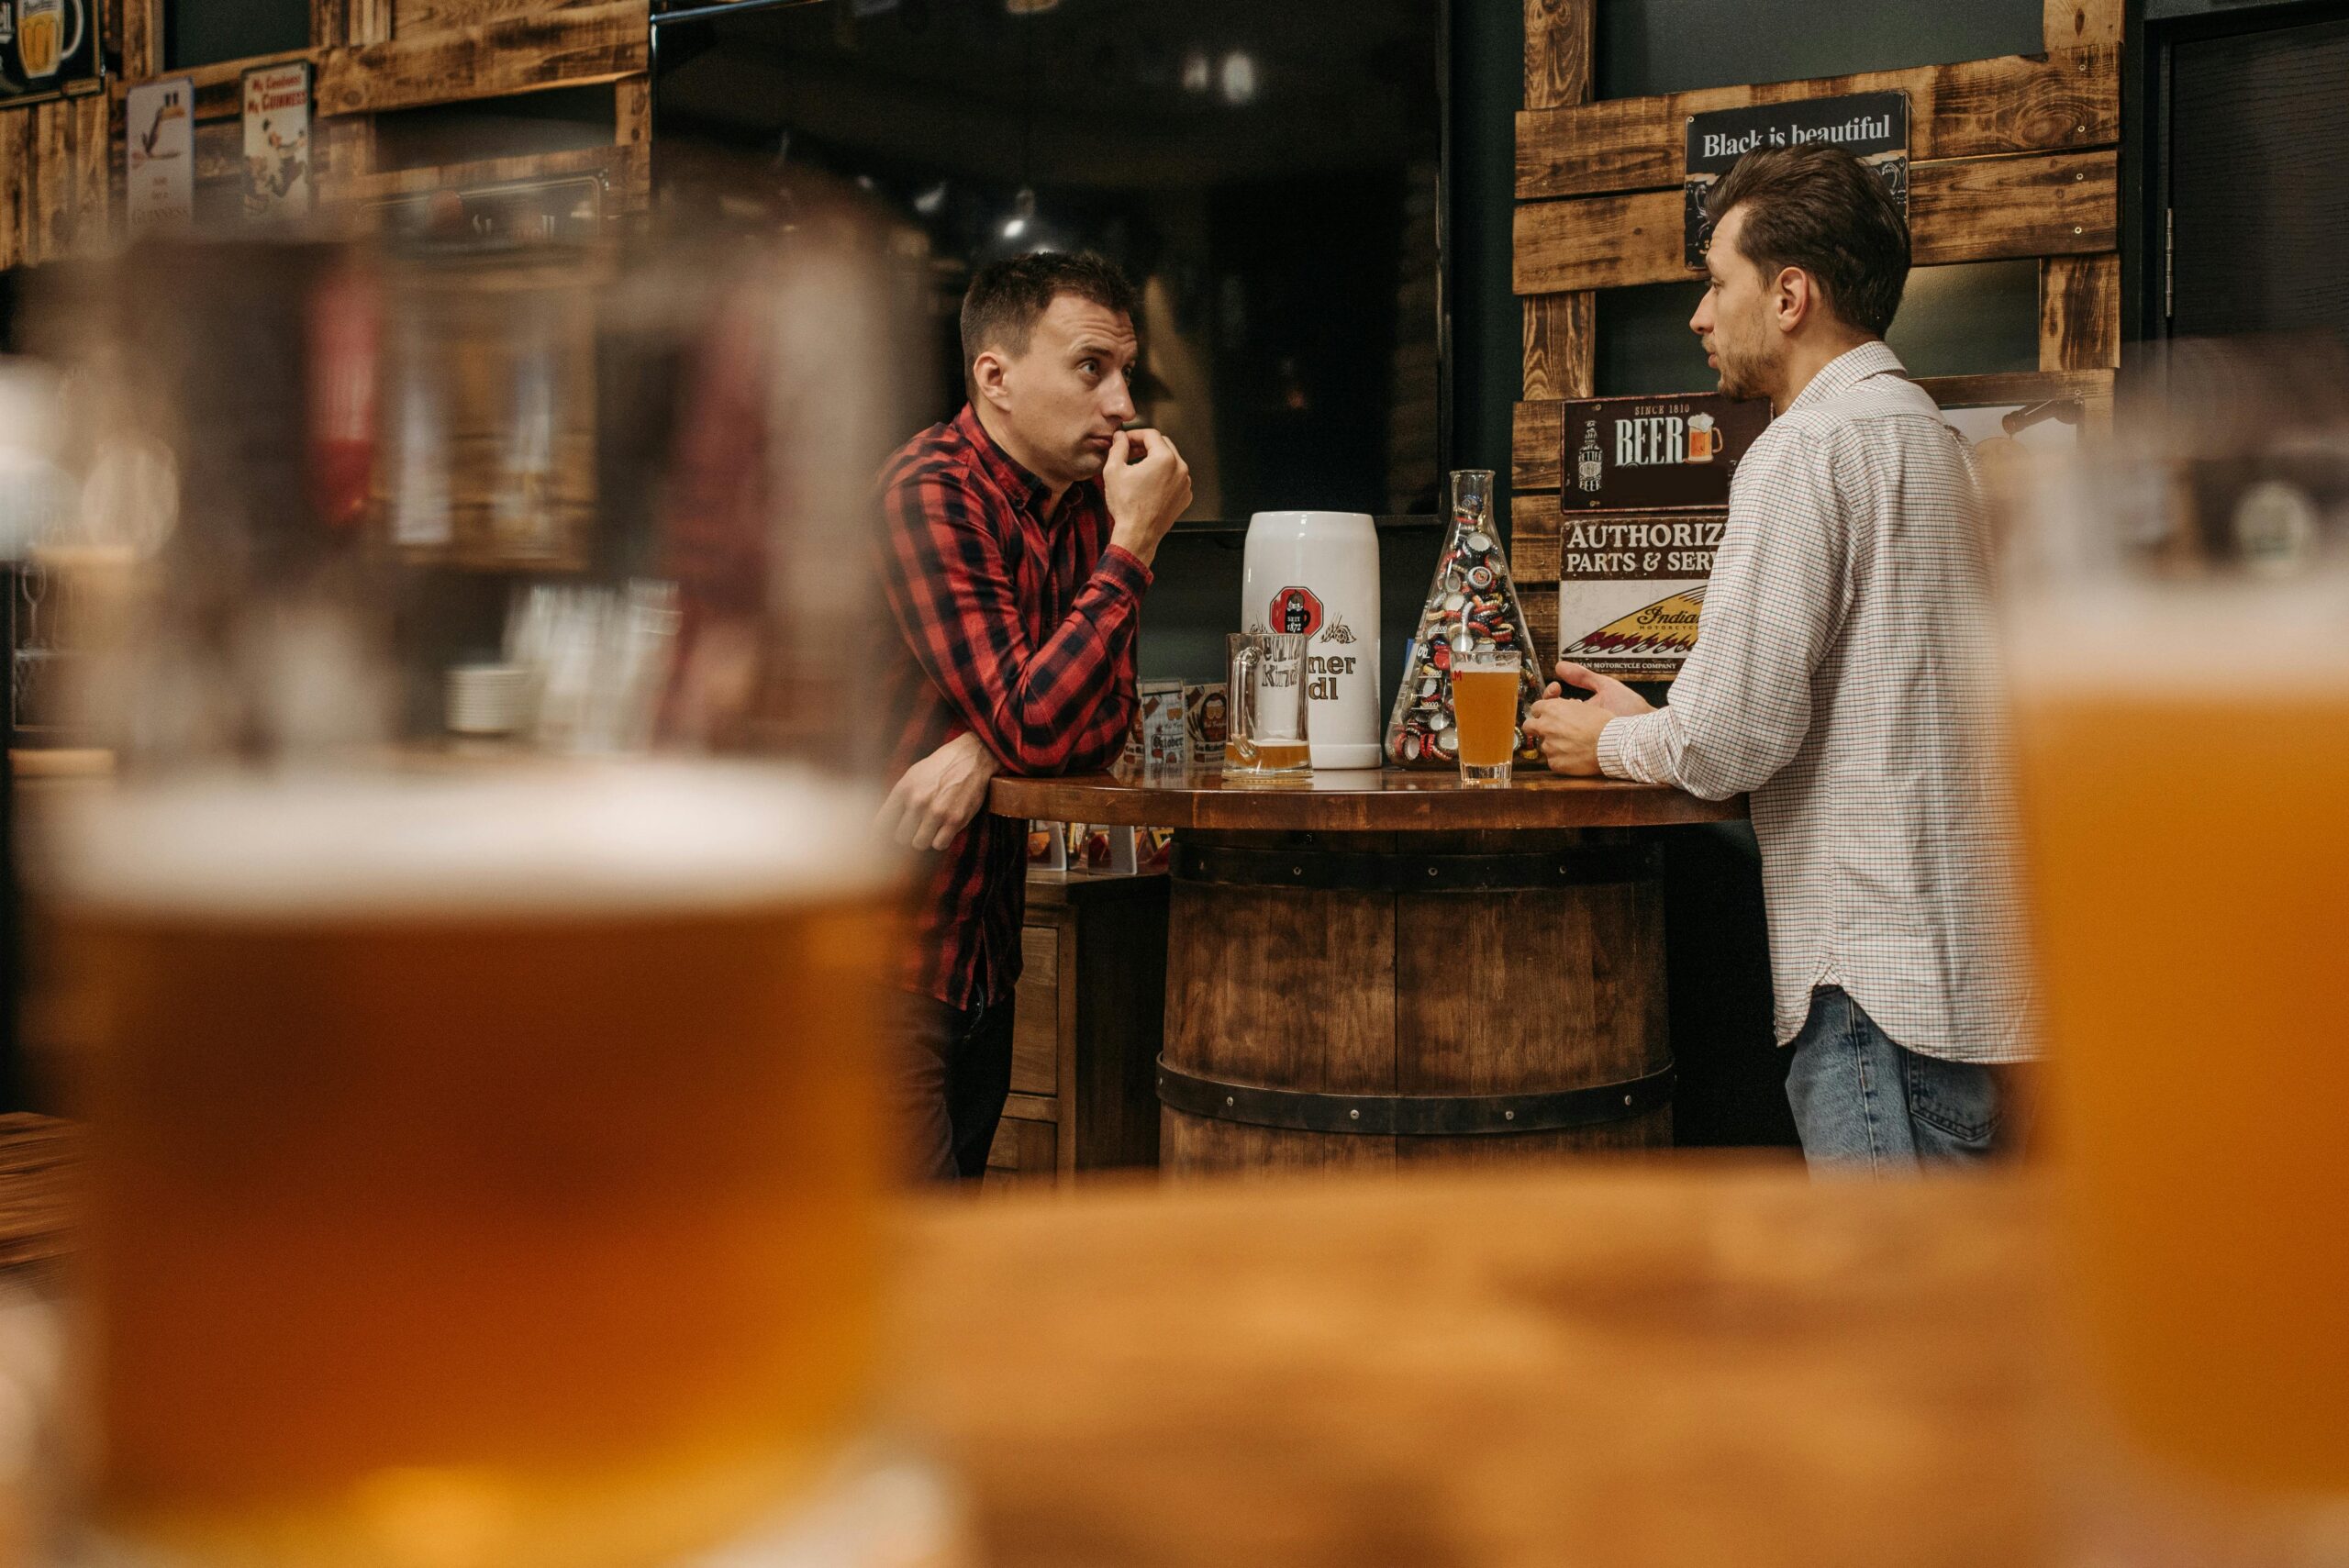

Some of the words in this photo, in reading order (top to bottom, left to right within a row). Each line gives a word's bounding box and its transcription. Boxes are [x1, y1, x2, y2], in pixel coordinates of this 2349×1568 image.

[262, 91, 307, 111] GUINNESS
[1703, 129, 1764, 158] Black
[1769, 127, 1786, 147] is
[1791, 115, 1891, 146] beautiful
[1634, 406, 1664, 416] SINCE
[1669, 403, 1690, 414] 1810
[1615, 417, 1684, 467] BEER
[1566, 523, 1729, 549] AUTHORIZ
[1566, 552, 1637, 573] PARTS
[1642, 551, 1662, 573] &
[1286, 623, 1302, 633] 1872
